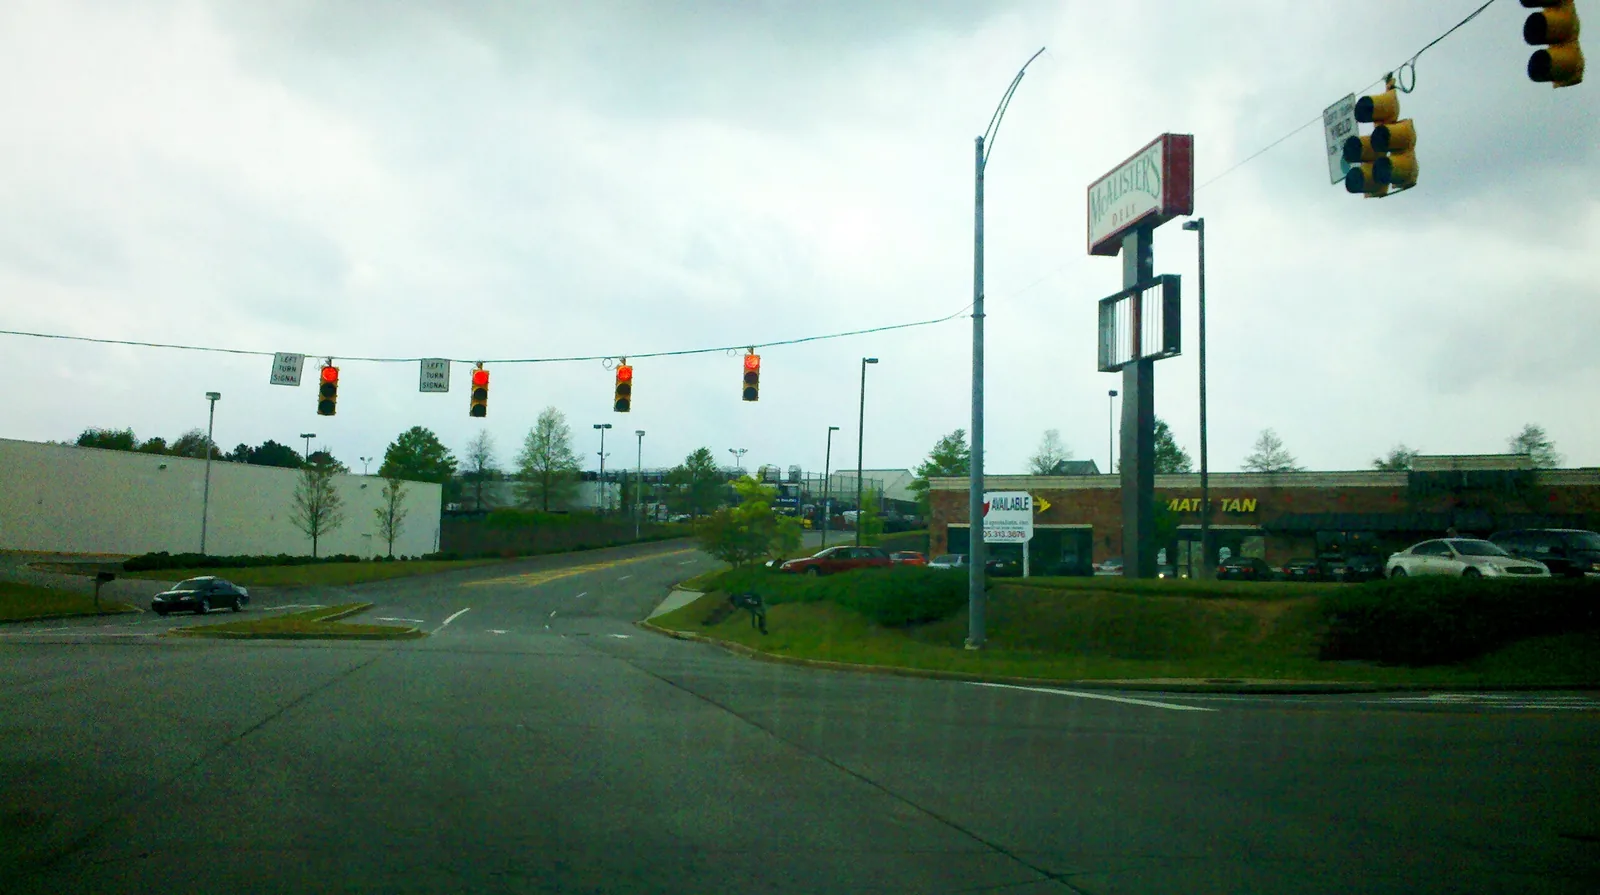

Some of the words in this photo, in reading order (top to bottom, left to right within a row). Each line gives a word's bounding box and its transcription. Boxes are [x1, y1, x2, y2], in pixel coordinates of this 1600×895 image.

[1330, 117, 1352, 139] YIELD
[1112, 203, 1136, 227] DELI
[279, 364, 297, 372] TURN
[272, 374, 297, 382] SIGNAL
[426, 371, 444, 379] TURN
[422, 381, 446, 389] SIGNAL
[992, 496, 1029, 511] AVAILABLE
[1221, 498, 1257, 512] TAN
